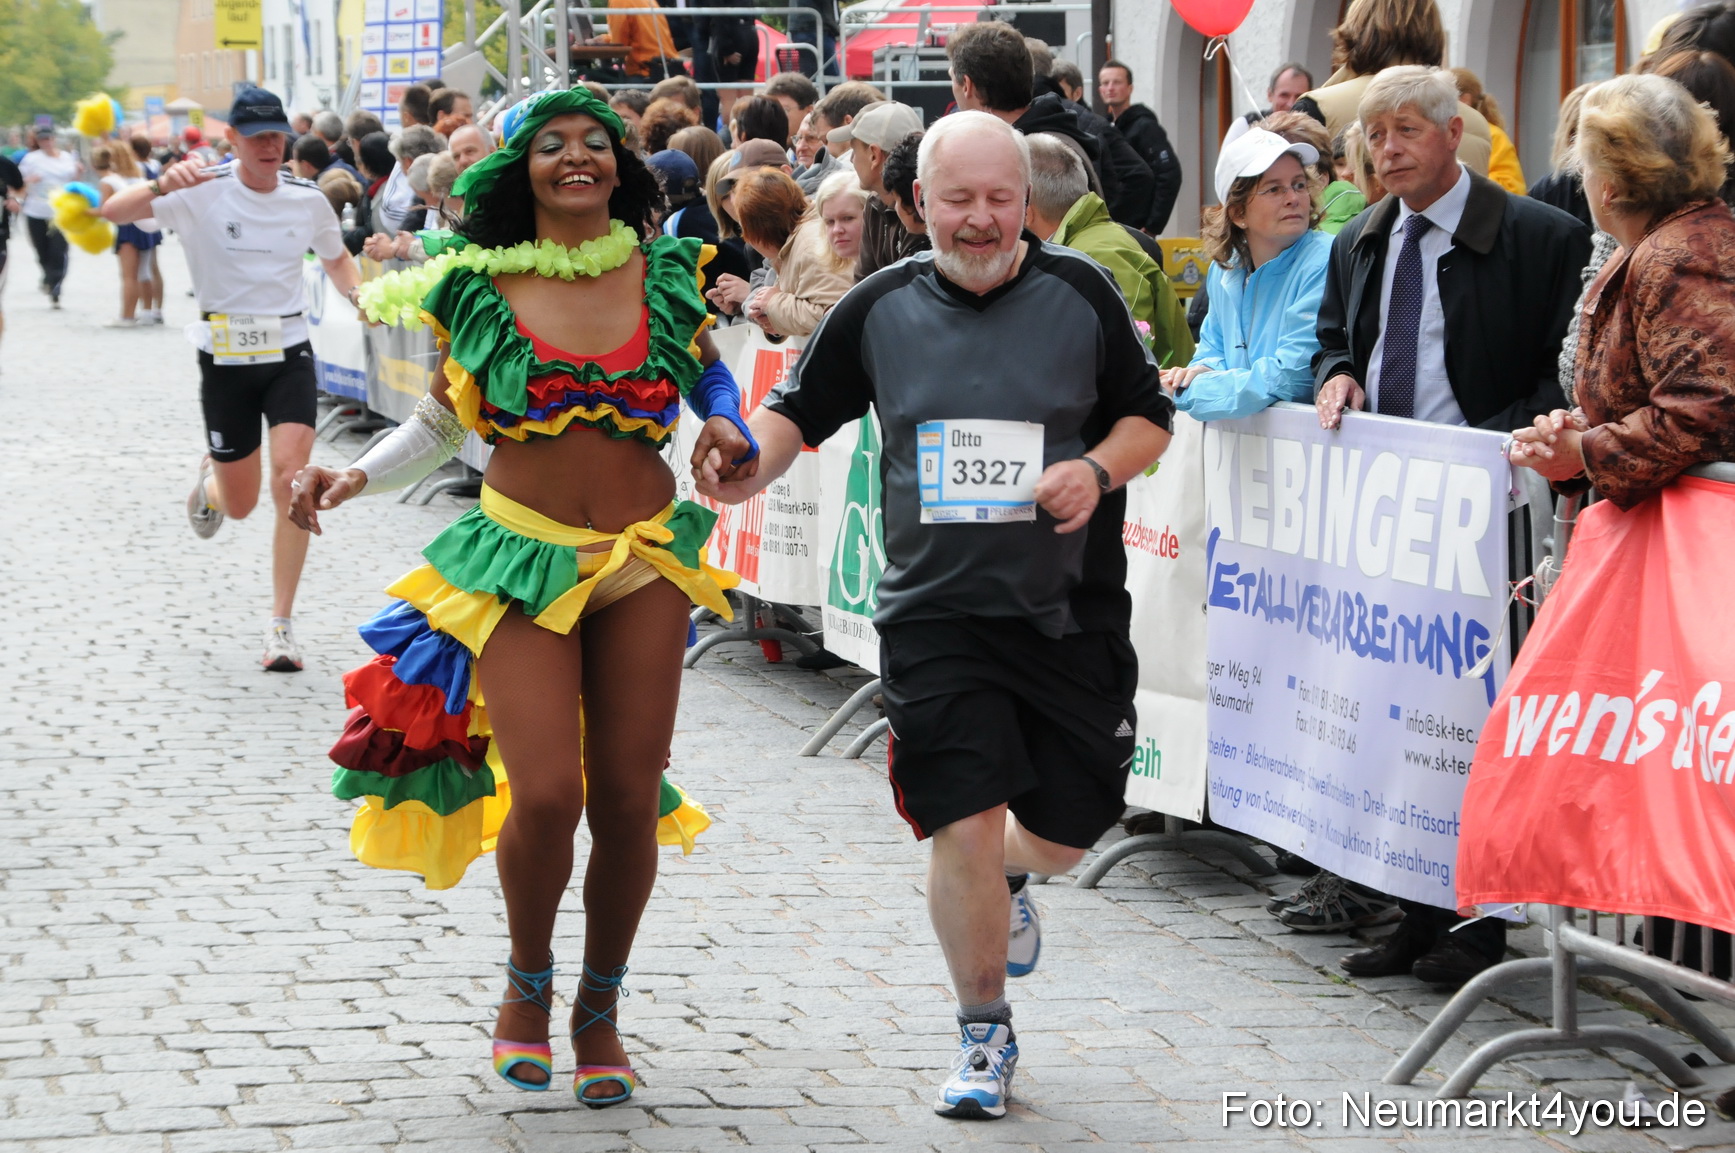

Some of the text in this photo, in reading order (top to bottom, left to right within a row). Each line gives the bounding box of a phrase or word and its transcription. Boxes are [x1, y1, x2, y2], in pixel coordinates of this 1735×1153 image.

[229, 315, 255, 325] Frank
[238, 331, 268, 347] 351
[952, 429, 982, 447] Otto
[951, 459, 1027, 486] 3327
[1203, 427, 1493, 598] KEBINGER
[1229, 659, 1250, 690] Weg
[1252, 666, 1262, 687] 94
[1209, 684, 1254, 715] Neumarkt
[1350, 701, 1360, 723] 45
[1347, 732, 1357, 755] 46
[1132, 736, 1162, 781] eih
[1389, 800, 1407, 827] und
[1209, 776, 1242, 809] eitung
[1245, 791, 1261, 809] von
[1383, 840, 1450, 887] Gestaltung
